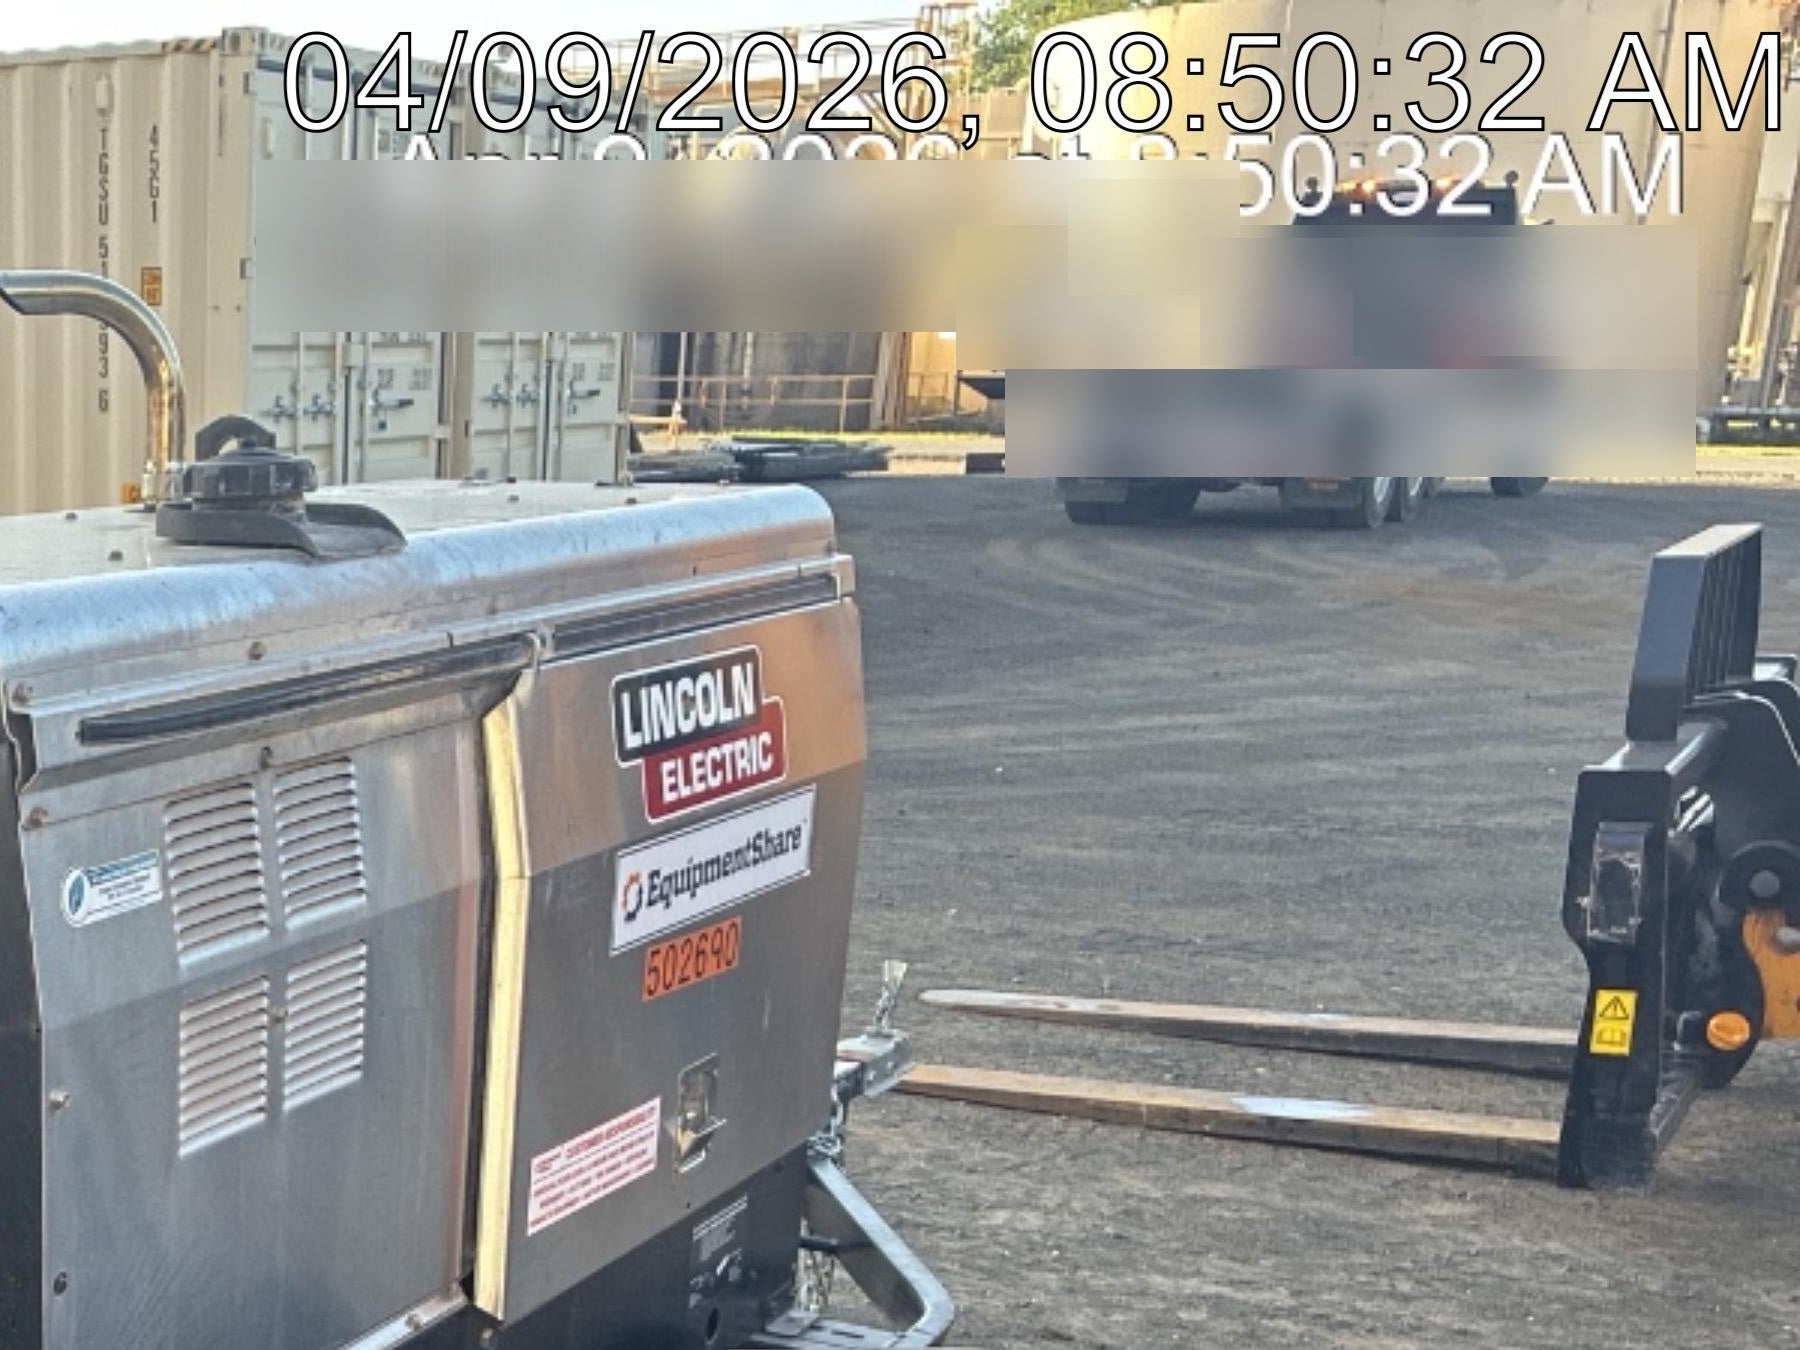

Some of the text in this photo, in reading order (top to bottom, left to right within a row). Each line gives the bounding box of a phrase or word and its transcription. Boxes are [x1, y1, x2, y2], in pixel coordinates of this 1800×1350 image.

[98, 235, 109, 379] 5193
[621, 661, 755, 749] LINCOLN
[659, 731, 773, 804] ELECTRIC
[645, 820, 804, 909] EquipmentShare
[645, 920, 739, 998] 502690
